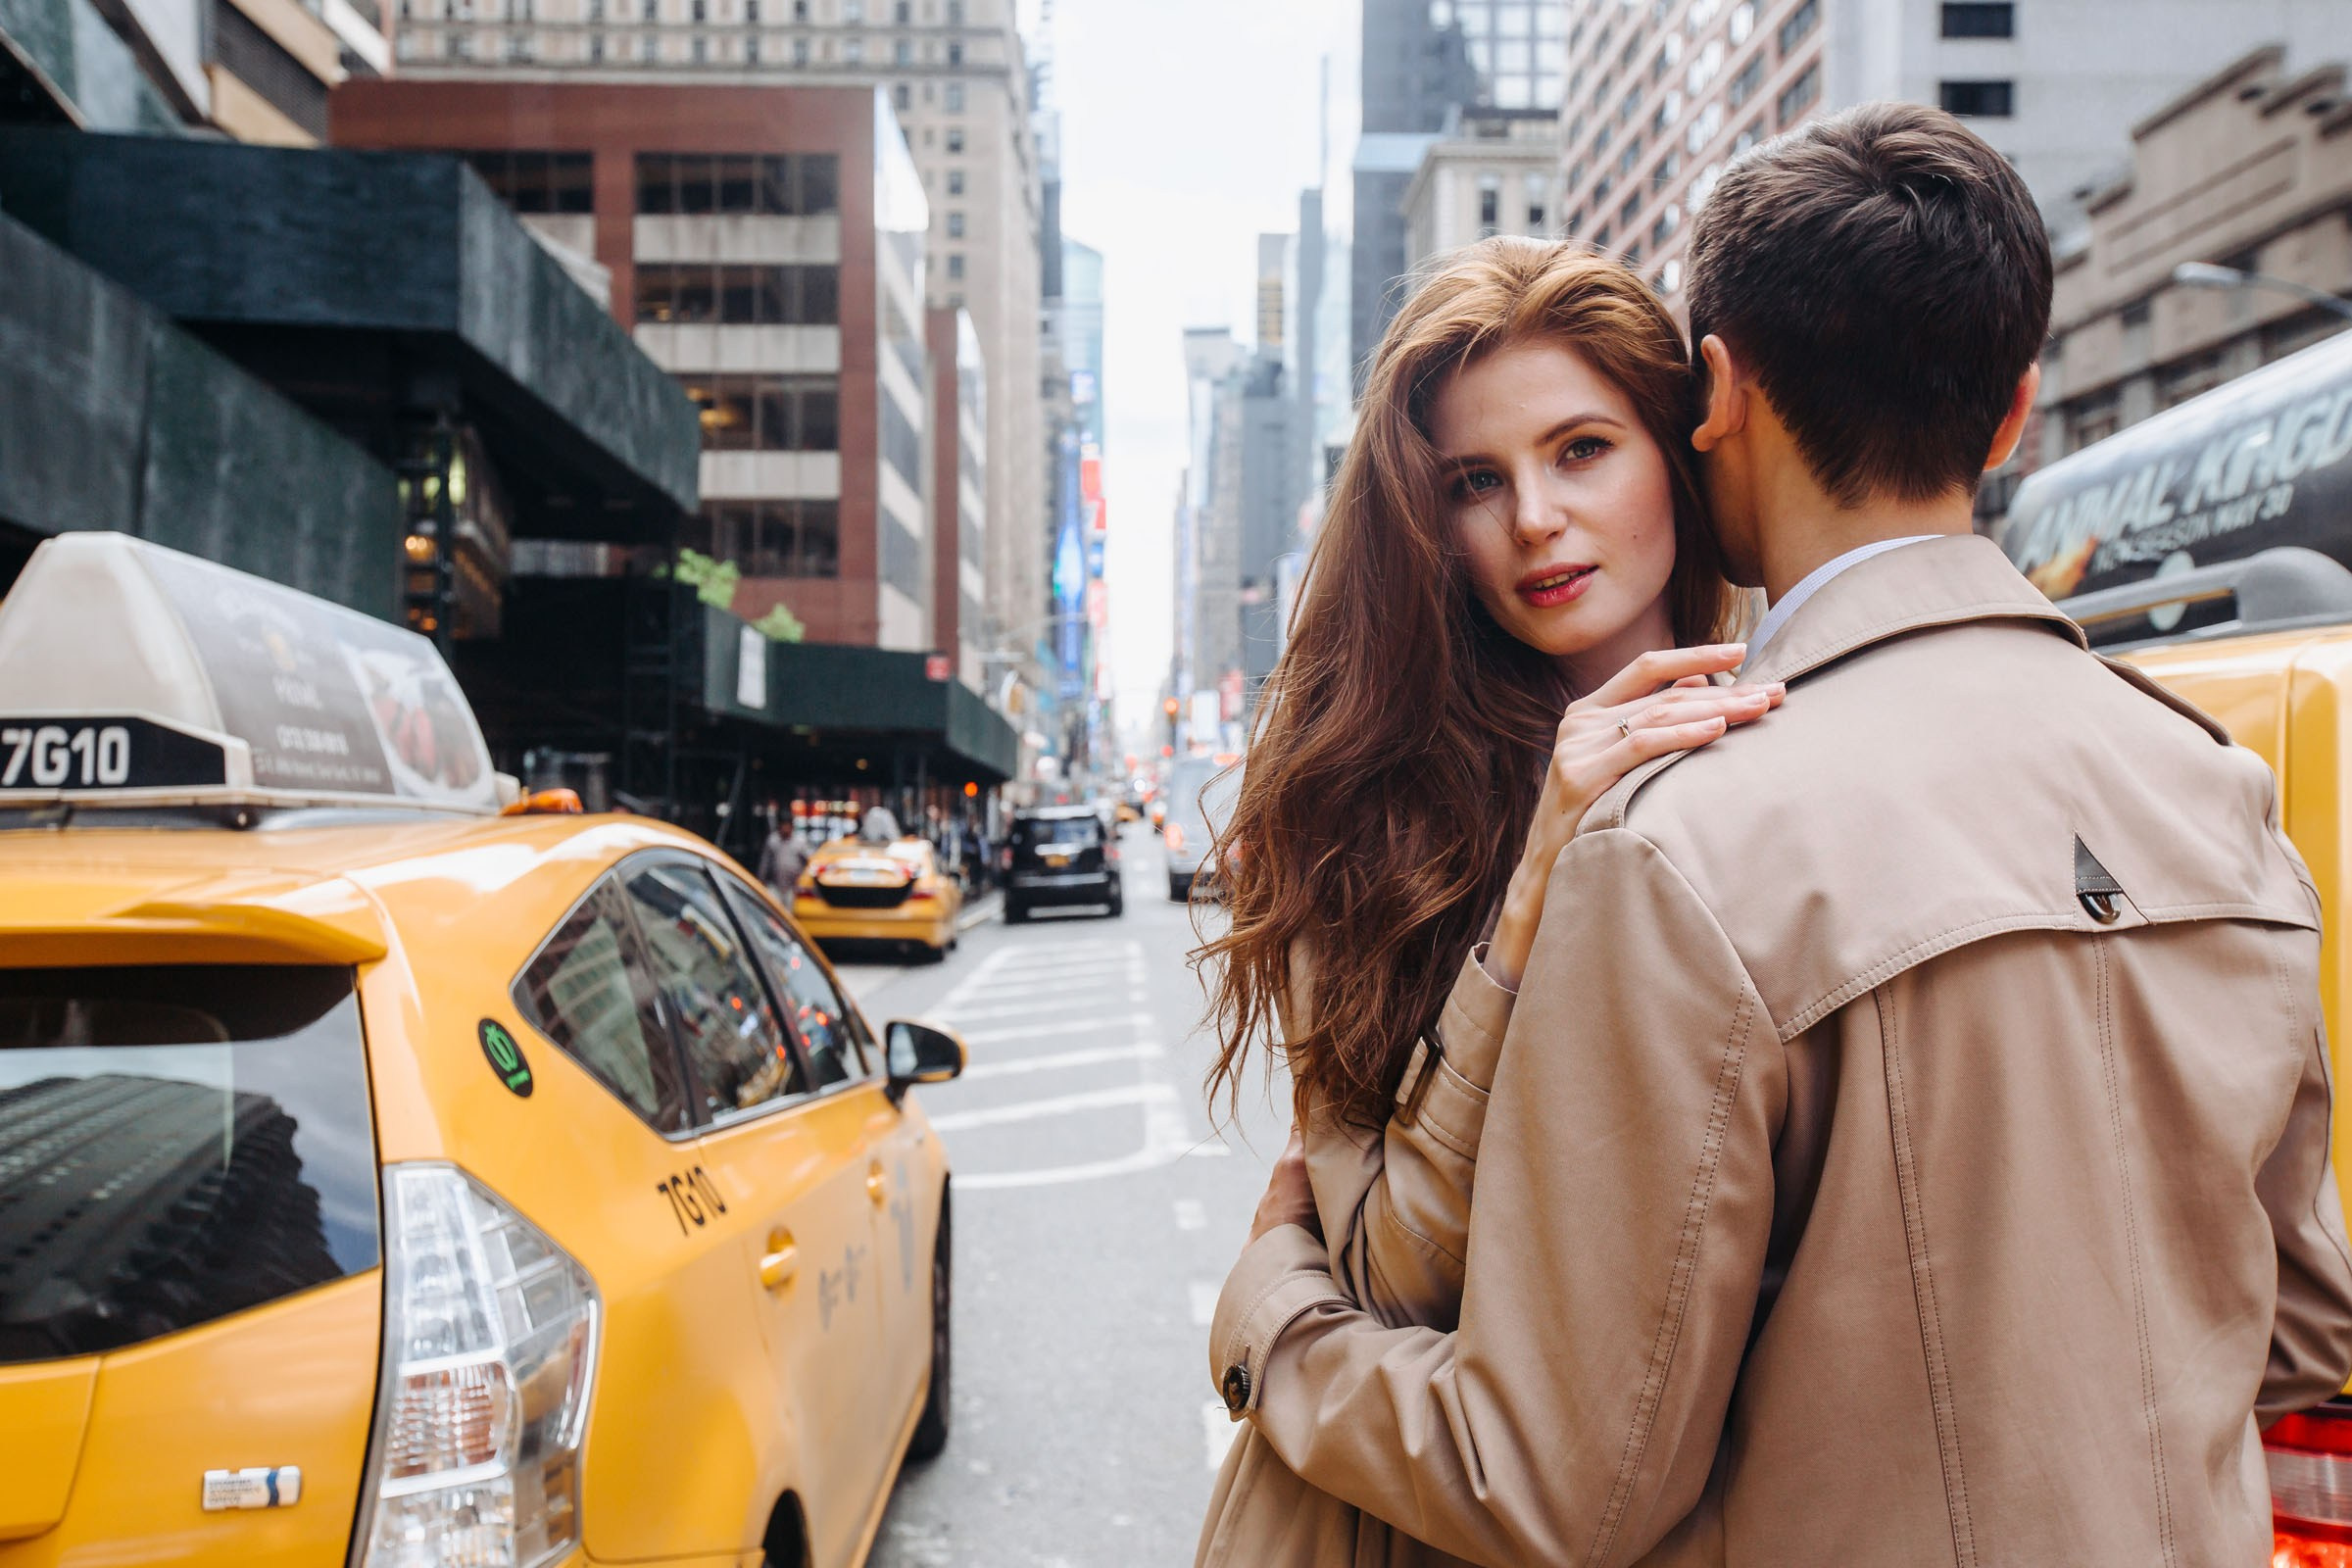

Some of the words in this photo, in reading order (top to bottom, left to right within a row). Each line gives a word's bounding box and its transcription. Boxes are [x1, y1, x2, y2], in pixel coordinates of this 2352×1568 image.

[2260, 483, 2294, 520] 30
[2, 725, 130, 786] 7G10
[658, 1166, 727, 1236] 7G10
